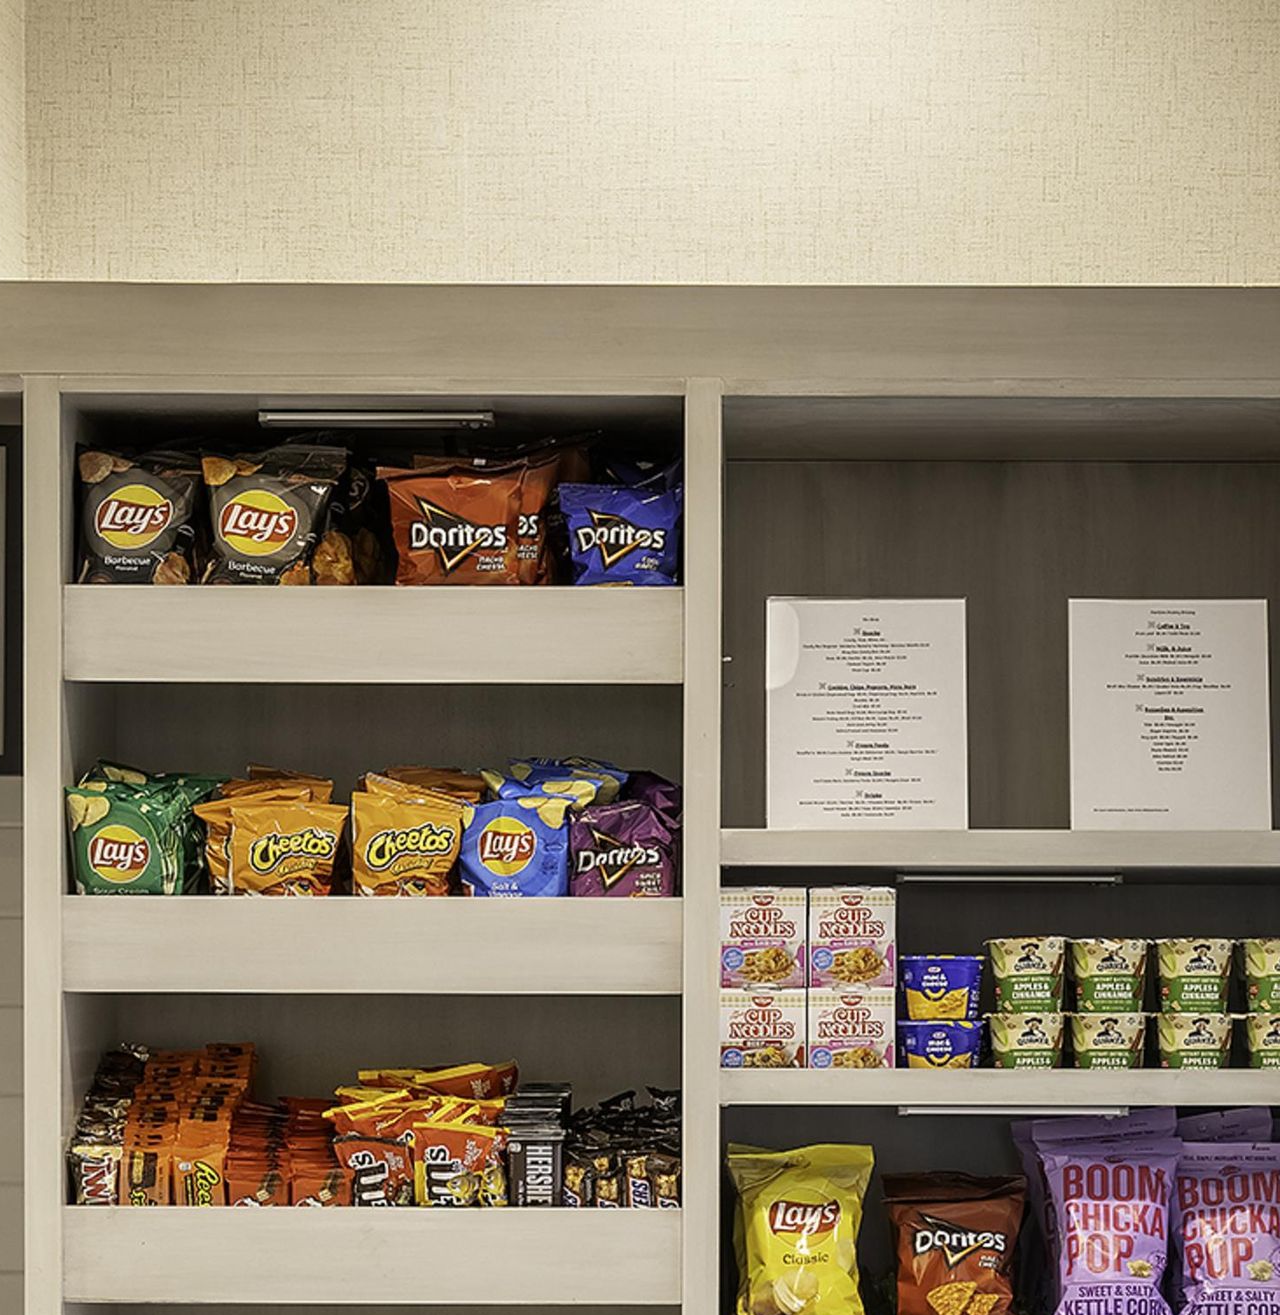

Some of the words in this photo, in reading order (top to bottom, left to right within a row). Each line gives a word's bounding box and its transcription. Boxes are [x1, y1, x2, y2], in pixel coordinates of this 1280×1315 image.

[100, 500, 167, 534] Lay's
[223, 504, 292, 542] Lay's
[411, 520, 507, 549] Doritos
[578, 523, 665, 553] Doritos
[104, 555, 151, 566] Barbecue
[228, 561, 276, 575] Barbecue
[94, 840, 146, 870] Lay's
[252, 829, 336, 870] Cheetos
[367, 825, 454, 869] Cheetos
[483, 831, 533, 862] Lay's
[578, 846, 660, 872] Doritos
[492, 882, 510, 891] Salt
[511, 882, 518, 891] &
[745, 908, 783, 923] CUP
[834, 908, 872, 923] CUP
[729, 921, 796, 938] NOODLES
[818, 921, 885, 938] NOODLES
[744, 1009, 782, 1024] CUP
[833, 1008, 871, 1024] CUP
[729, 1021, 796, 1038] NOODLES
[818, 1021, 884, 1038] NOODLES
[1063, 1164, 1166, 1206] BOOM
[773, 1202, 837, 1235] Lay's
[1065, 1201, 1165, 1240] CHICKA
[1182, 1204, 1280, 1241] CHICKA
[915, 1231, 1005, 1253] Doritos
[1066, 1232, 1134, 1276] POP
[783, 1254, 828, 1266] Classic
[1184, 1238, 1253, 1282] POP
[1079, 1285, 1114, 1297] SWEET
[1116, 1285, 1124, 1297] &
[1125, 1285, 1154, 1298] SALTY
[1201, 1291, 1234, 1302] SWEET
[1235, 1291, 1243, 1301] &
[1245, 1290, 1275, 1301] SALTY
